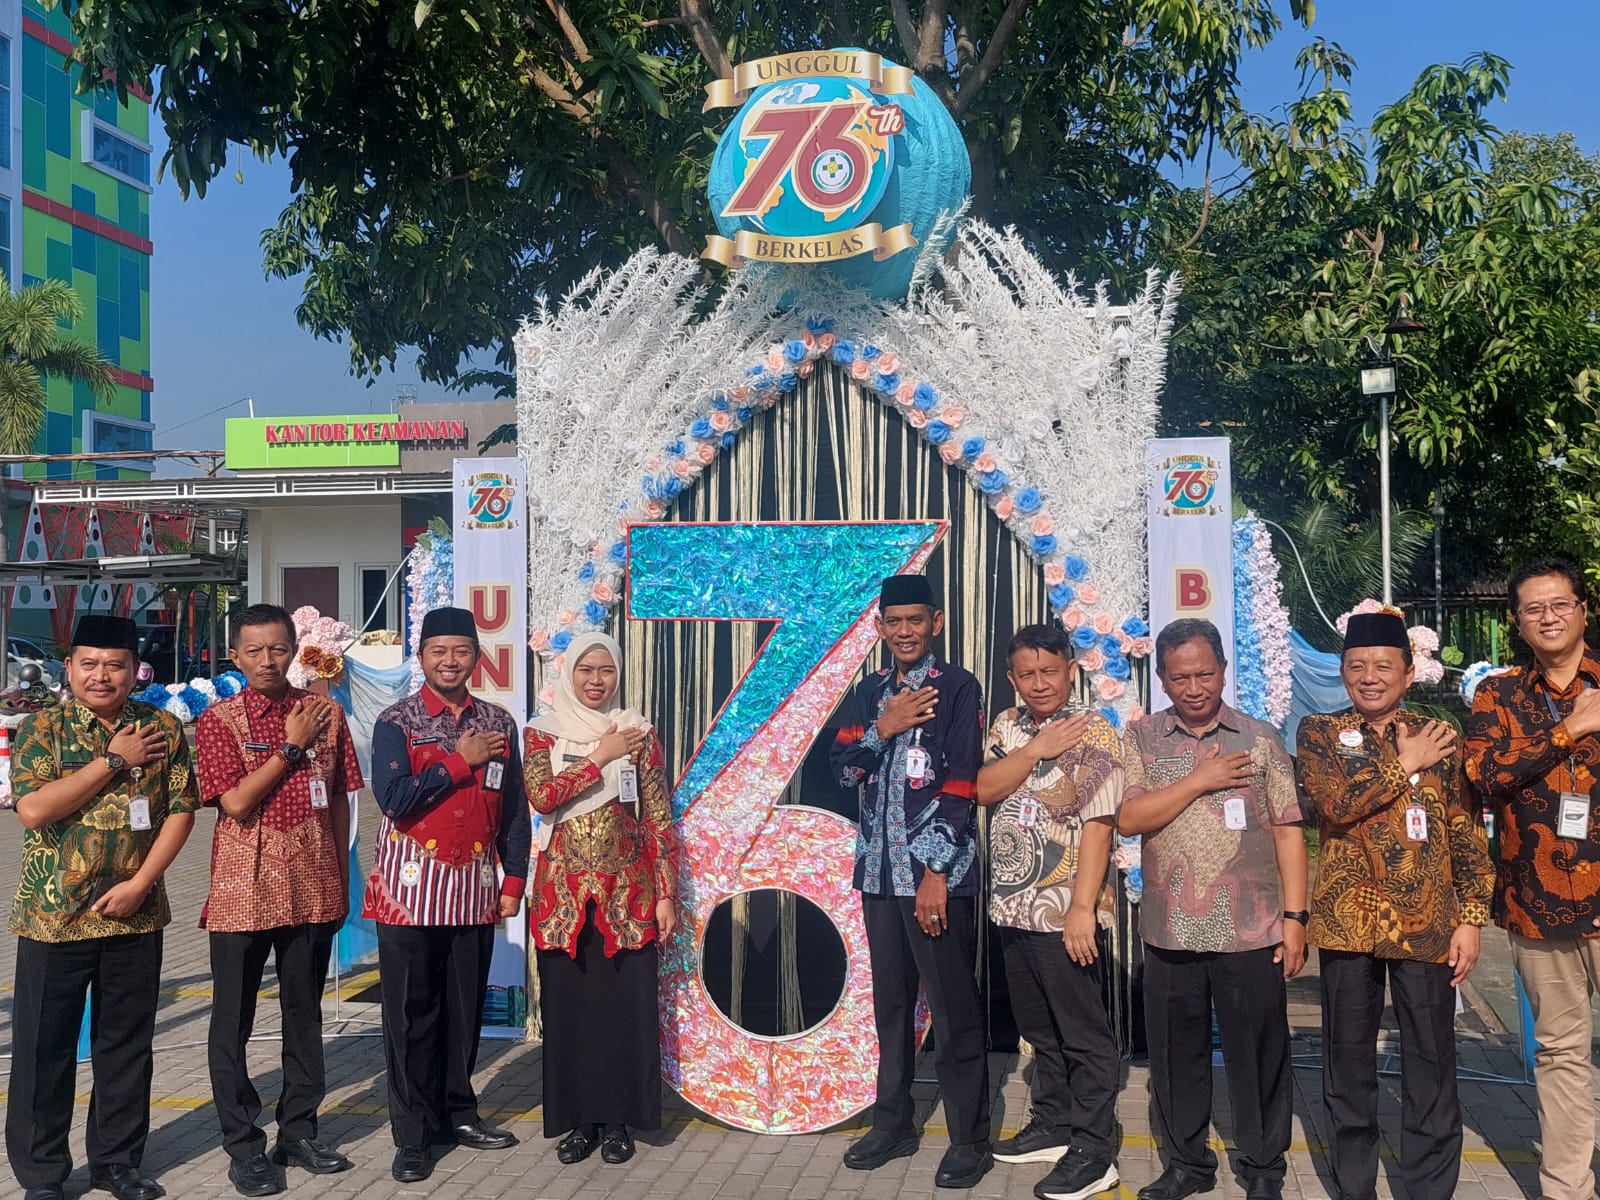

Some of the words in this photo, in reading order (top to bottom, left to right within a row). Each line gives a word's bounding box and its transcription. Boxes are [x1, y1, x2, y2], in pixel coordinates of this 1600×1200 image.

[757, 55, 862, 80] UNGGUL
[755, 234, 864, 258] BERKELAS
[266, 423, 346, 443] KANTOR
[353, 420, 465, 441] KEAMANAN
